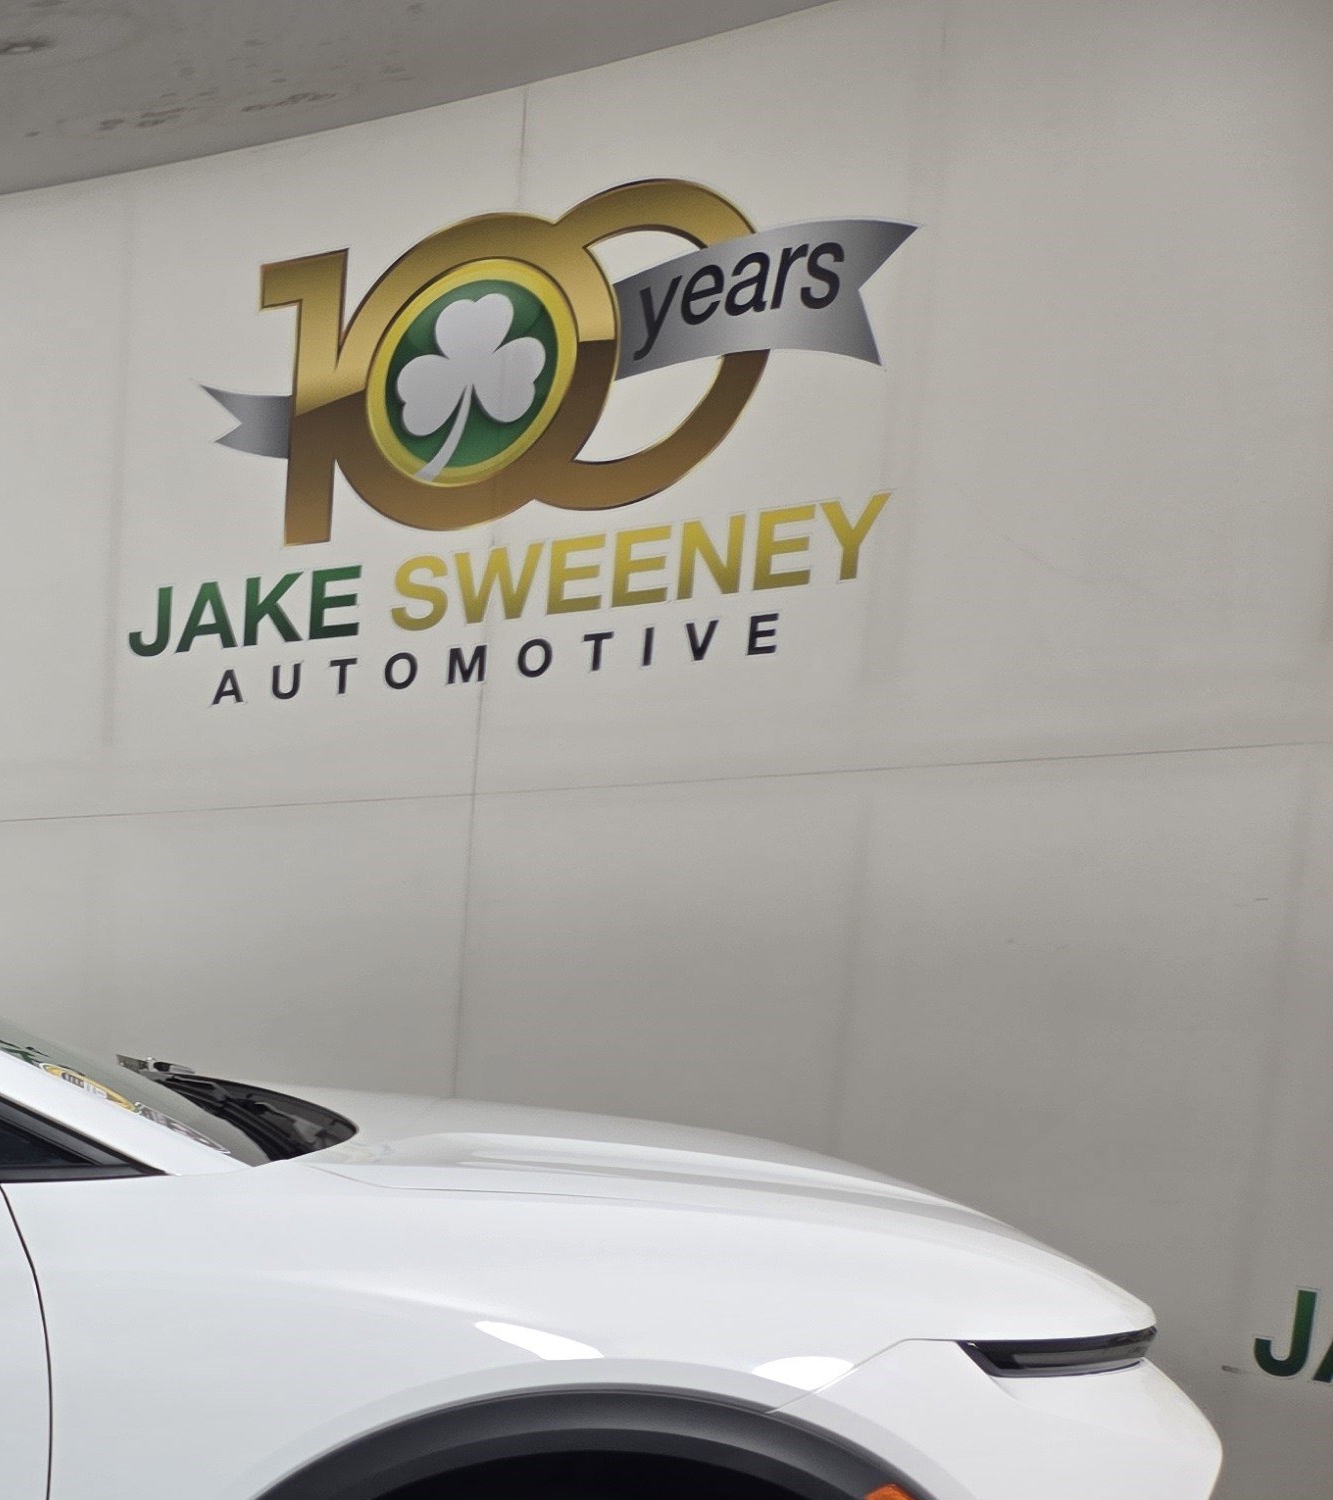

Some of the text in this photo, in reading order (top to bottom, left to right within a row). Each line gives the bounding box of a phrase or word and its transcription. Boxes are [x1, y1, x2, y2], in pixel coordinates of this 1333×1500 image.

[259, 178, 845, 548] 100 years
[128, 493, 892, 658] JAKE SWEENEY
[212, 612, 779, 706] AUTOMOTIVE
